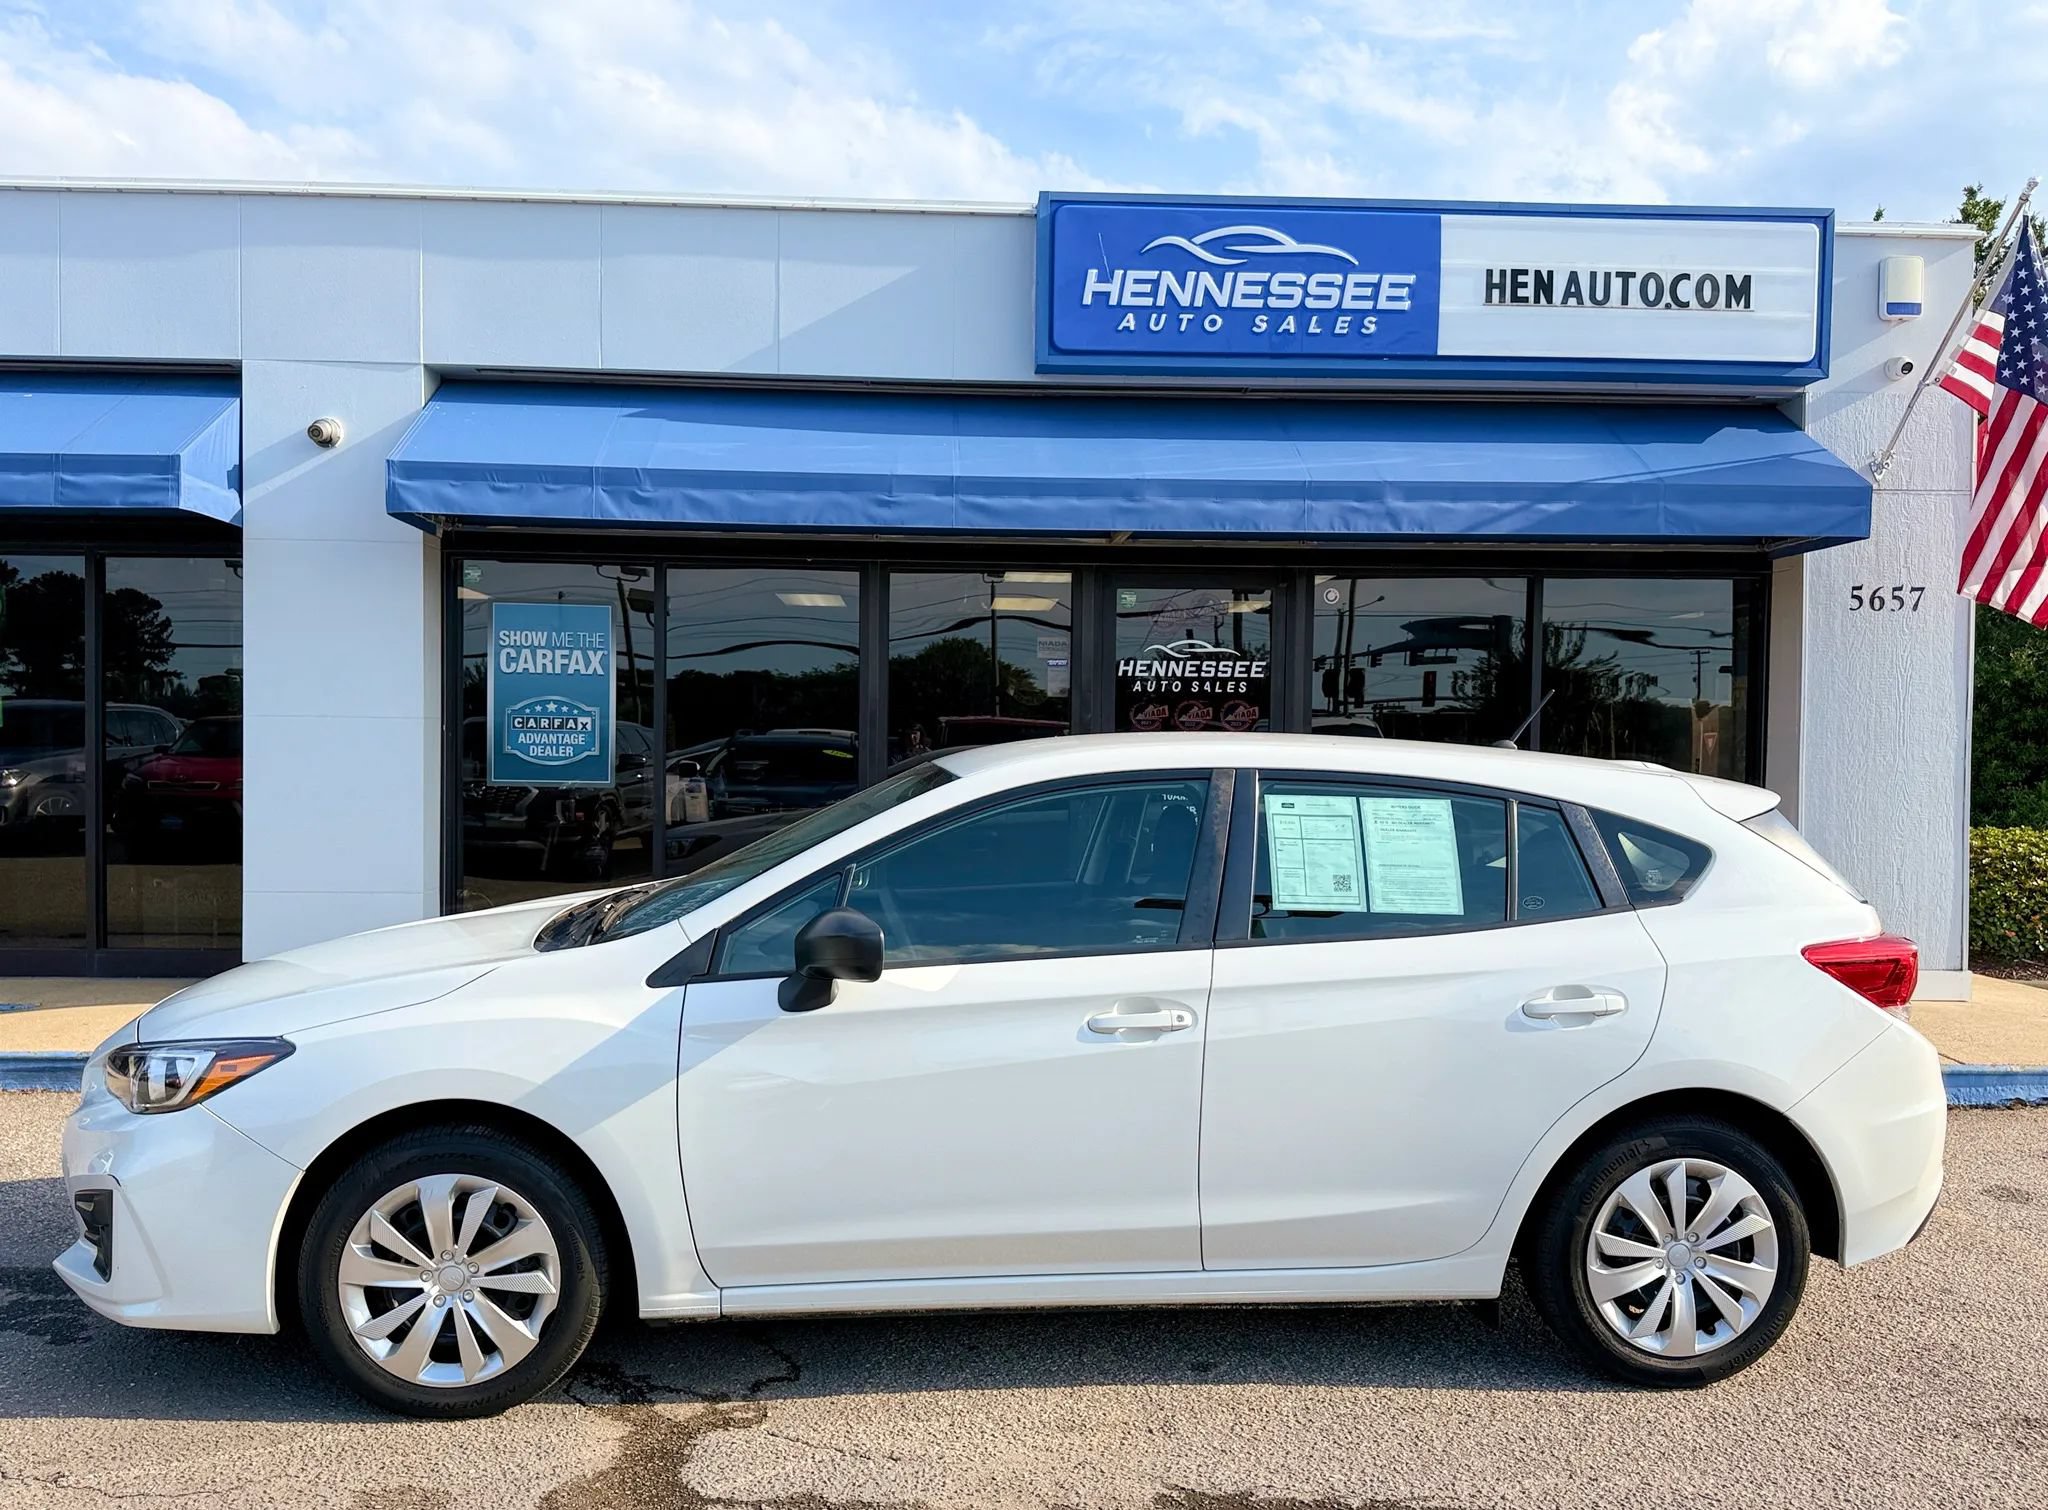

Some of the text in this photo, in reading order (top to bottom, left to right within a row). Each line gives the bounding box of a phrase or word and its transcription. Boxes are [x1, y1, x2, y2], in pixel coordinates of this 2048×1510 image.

[1082, 268, 1416, 312] HENNESSEE
[1484, 268, 1753, 310] HENAUTO.COM
[1116, 313, 1380, 336] AUTO SALES
[1848, 583, 1926, 612] 5657
[498, 630, 605, 649] SHOW ME THE
[499, 647, 605, 676] CARFAX
[1117, 660, 1267, 678] HENNESSEE
[1132, 680, 1248, 693] AUTO SALES
[512, 716, 592, 732] CARFAX
[517, 732, 586, 746] ADVANTAGE
[529, 745, 575, 758] DEALER
[1580, 1142, 1643, 1206] Continental
